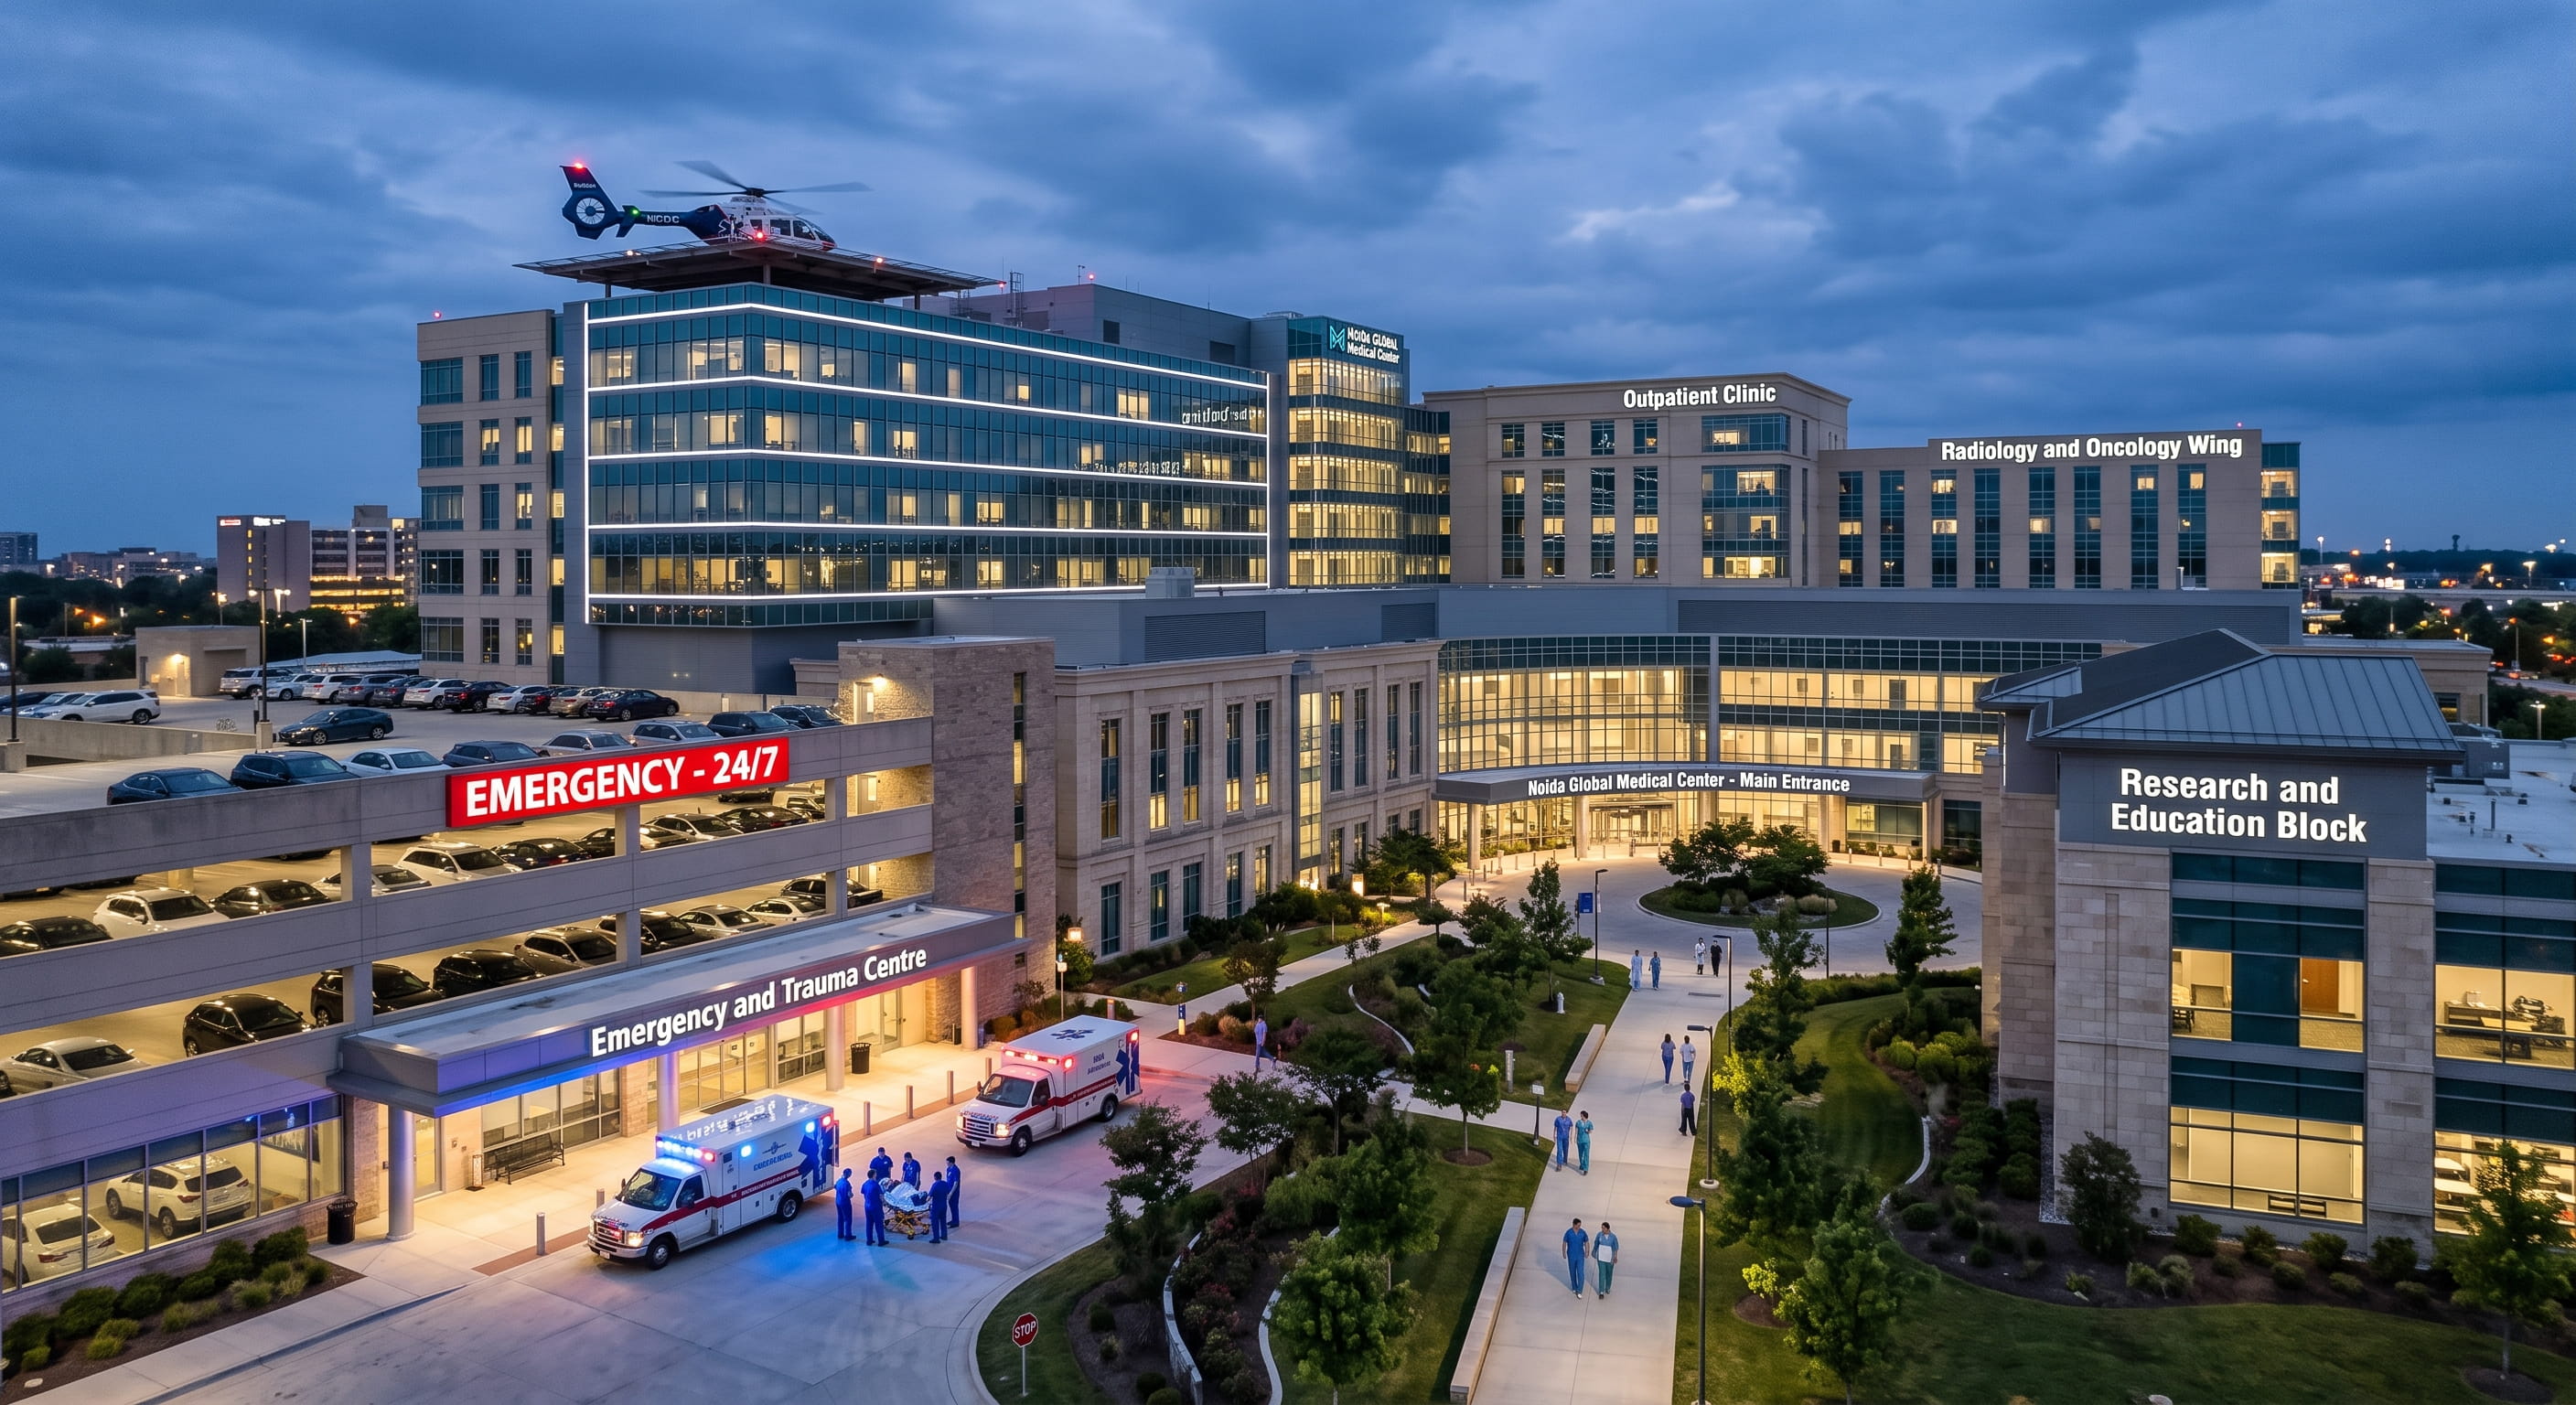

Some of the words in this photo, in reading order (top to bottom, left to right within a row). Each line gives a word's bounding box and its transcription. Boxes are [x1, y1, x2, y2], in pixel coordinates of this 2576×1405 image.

[1347, 341, 1376, 359] Medical
[1624, 387, 1718, 411] Outpatient
[1723, 383, 1776, 404] Clinic
[1941, 441, 2038, 464] Radiology
[2044, 438, 2079, 457] and
[2086, 436, 2182, 460] Oncology
[2188, 434, 2242, 458] Wing
[466, 756, 686, 818] EMERGENCY
[713, 745, 779, 786] 24/7
[1528, 778, 1565, 797] Noida
[1569, 775, 1613, 792] Global
[1616, 772, 1672, 789] Medical
[1677, 771, 1725, 788] Center
[1740, 772, 1777, 788] Main
[1782, 774, 1851, 792] Entrance
[2120, 767, 2268, 801] Research
[2280, 777, 2339, 804] and
[2111, 802, 2266, 838] Education
[2278, 810, 2367, 842] Block
[592, 1001, 728, 1057] Emergency
[734, 981, 775, 1019] and
[781, 968, 858, 1004] Trauma
[864, 948, 927, 981] Centre
[1014, 1320, 1036, 1339] STOP
